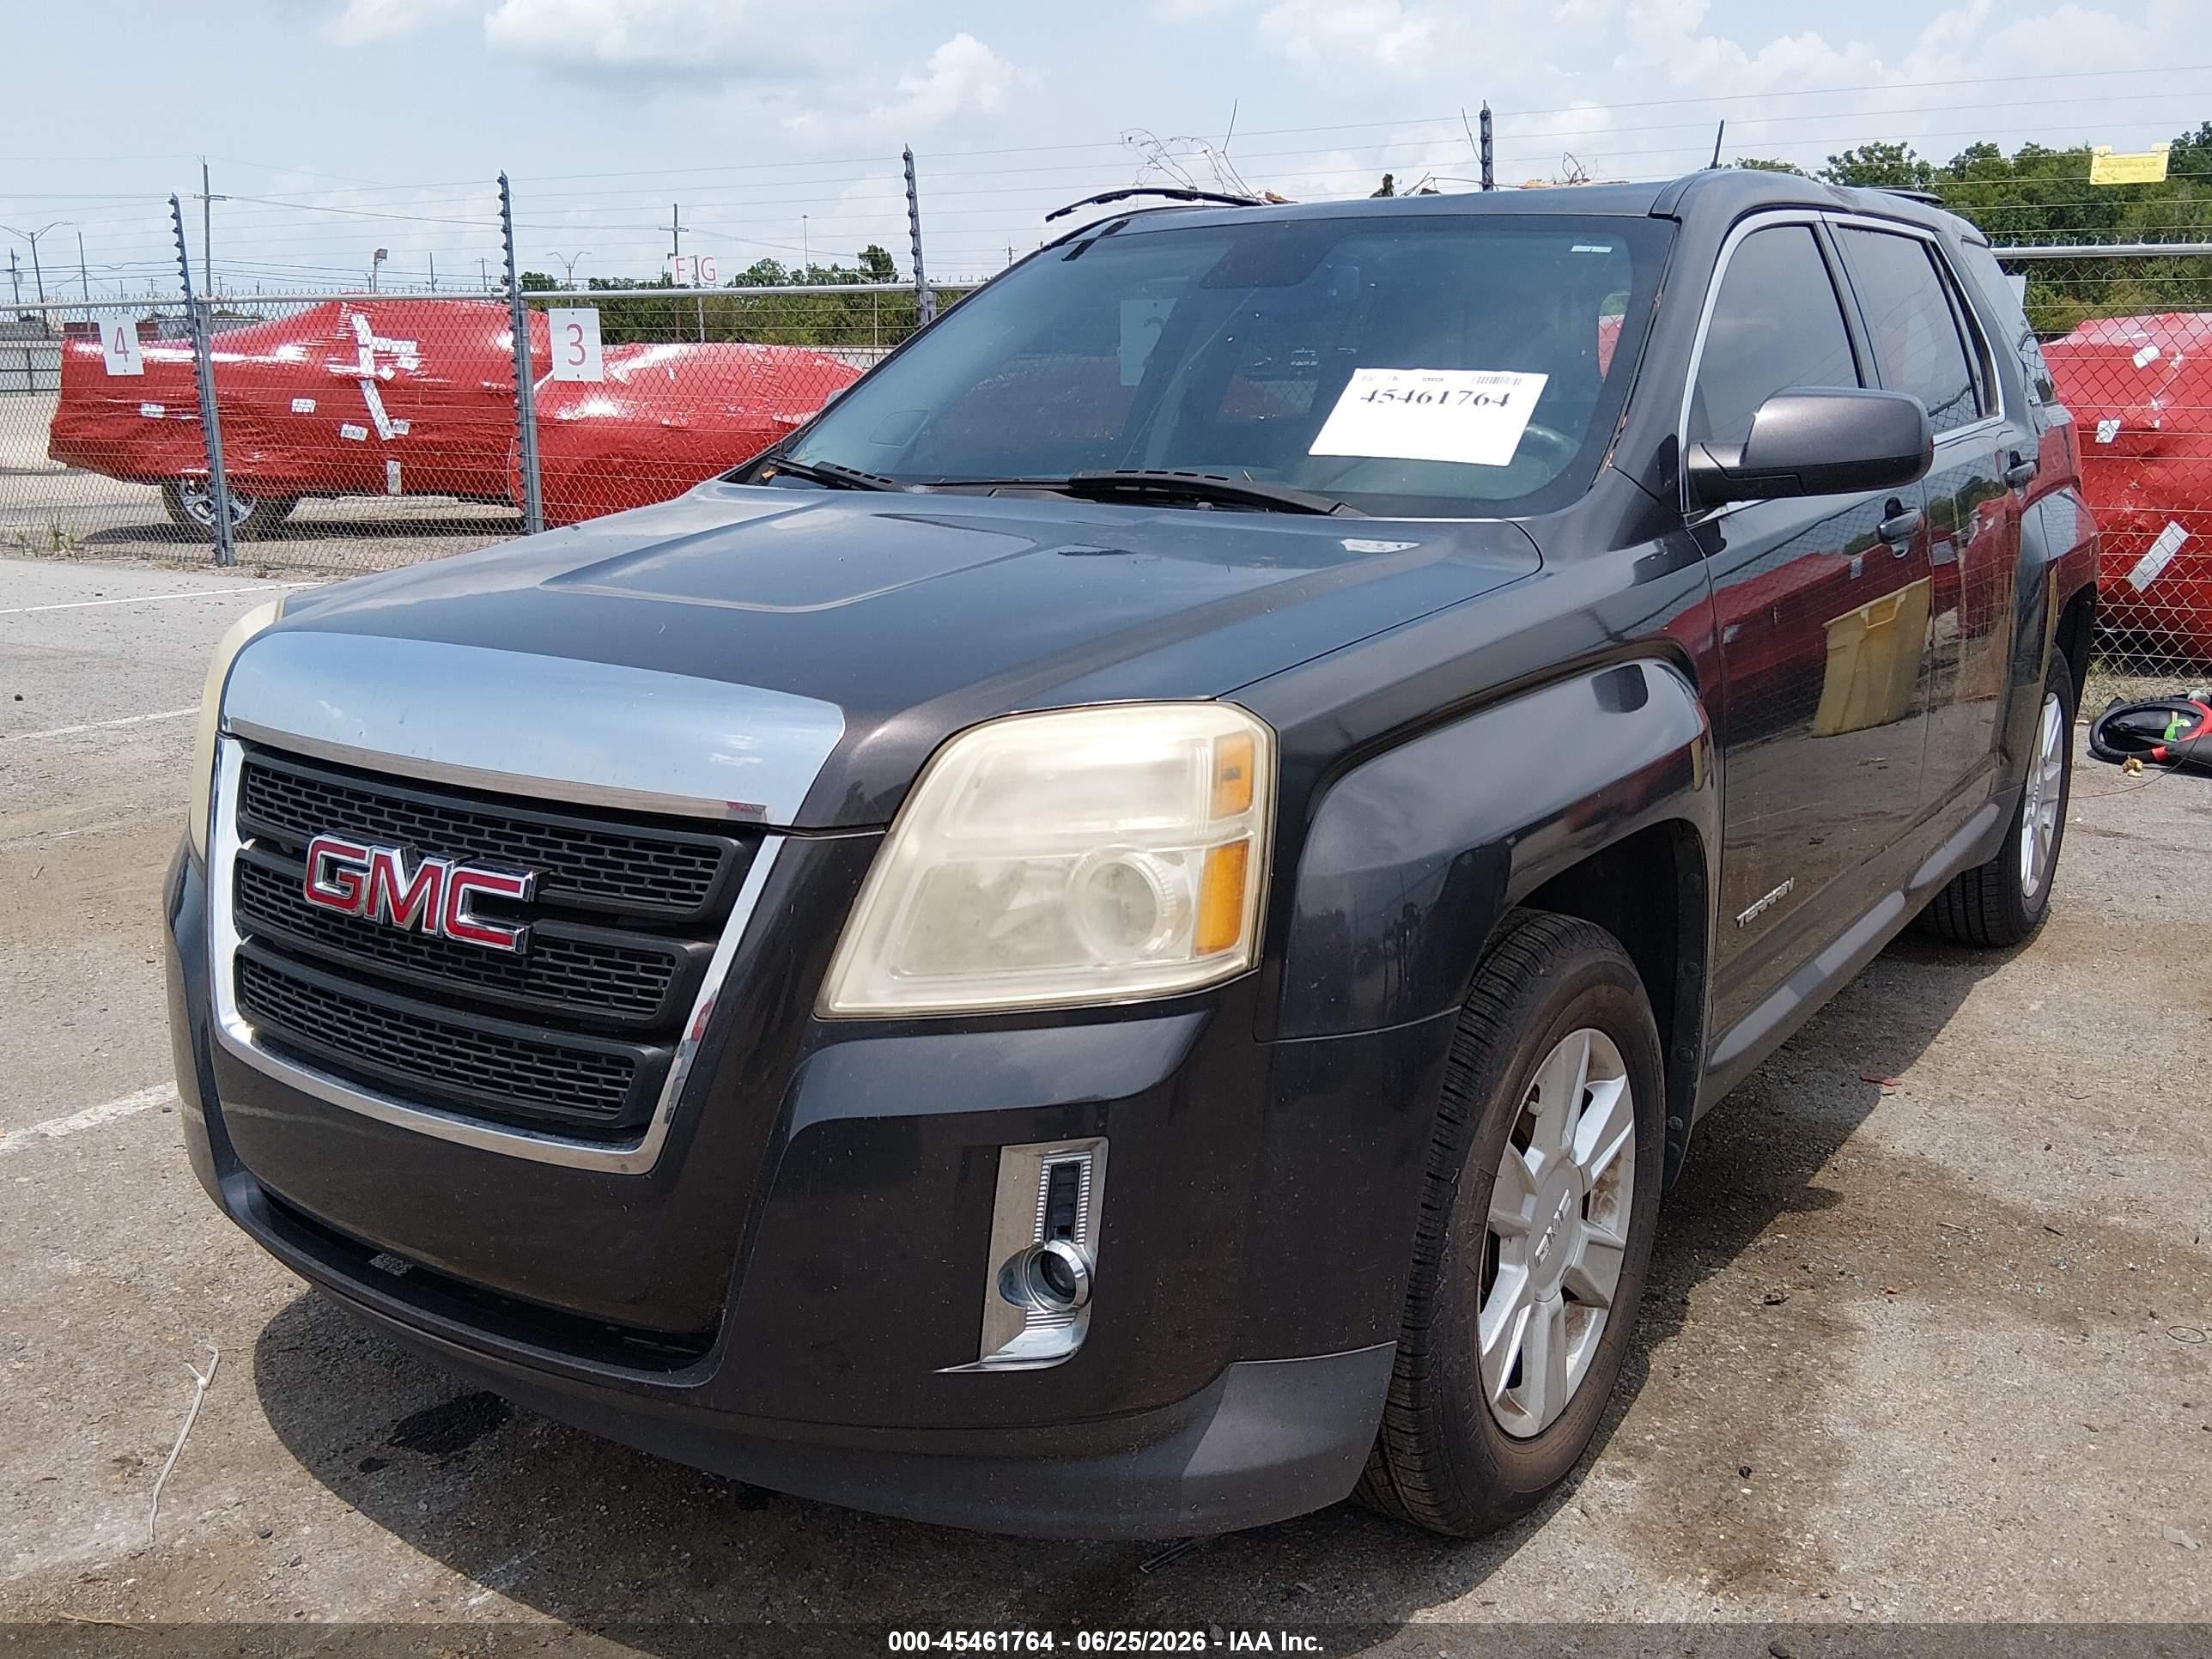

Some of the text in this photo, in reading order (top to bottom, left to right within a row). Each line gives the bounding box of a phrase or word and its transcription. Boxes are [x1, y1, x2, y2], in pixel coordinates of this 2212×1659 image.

[675, 258, 685, 283] F
[701, 257, 716, 282] G
[113, 325, 130, 362] 4
[565, 324, 587, 367] 3
[1360, 389, 1510, 408] 45461764
[304, 834, 534, 955] GMC
